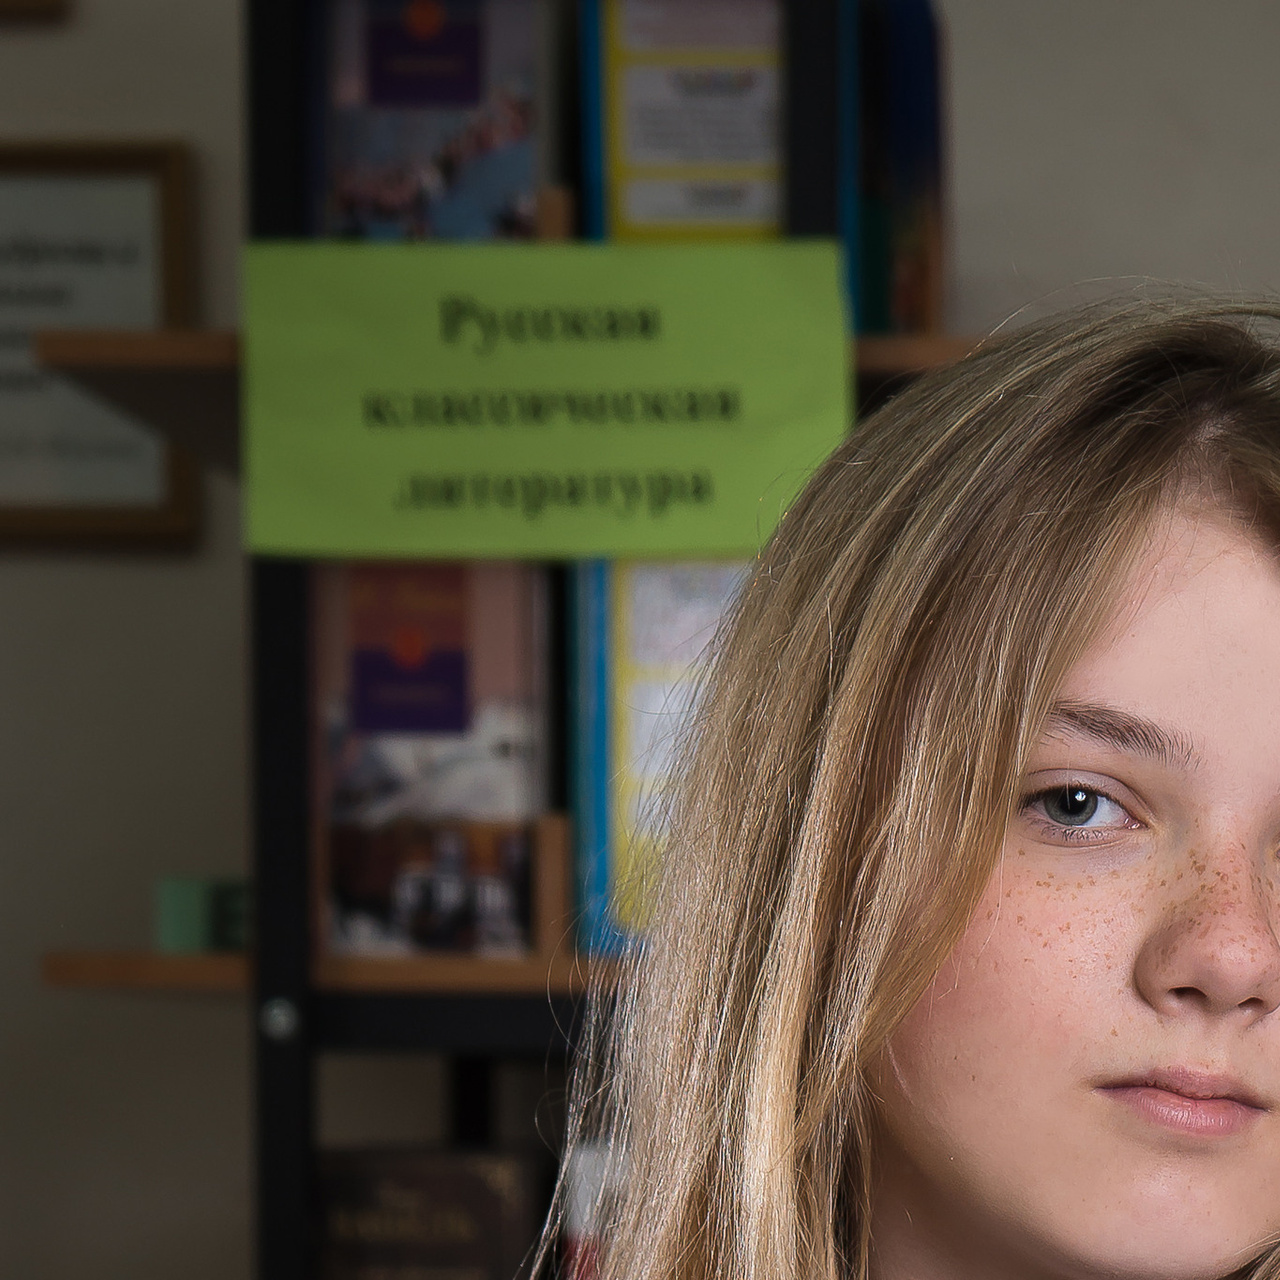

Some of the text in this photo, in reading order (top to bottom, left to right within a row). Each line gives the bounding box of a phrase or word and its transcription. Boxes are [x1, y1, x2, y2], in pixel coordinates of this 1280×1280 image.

[439, 292, 662, 356] Русская
[362, 384, 743, 428] классическая
[393, 467, 715, 522] литература
